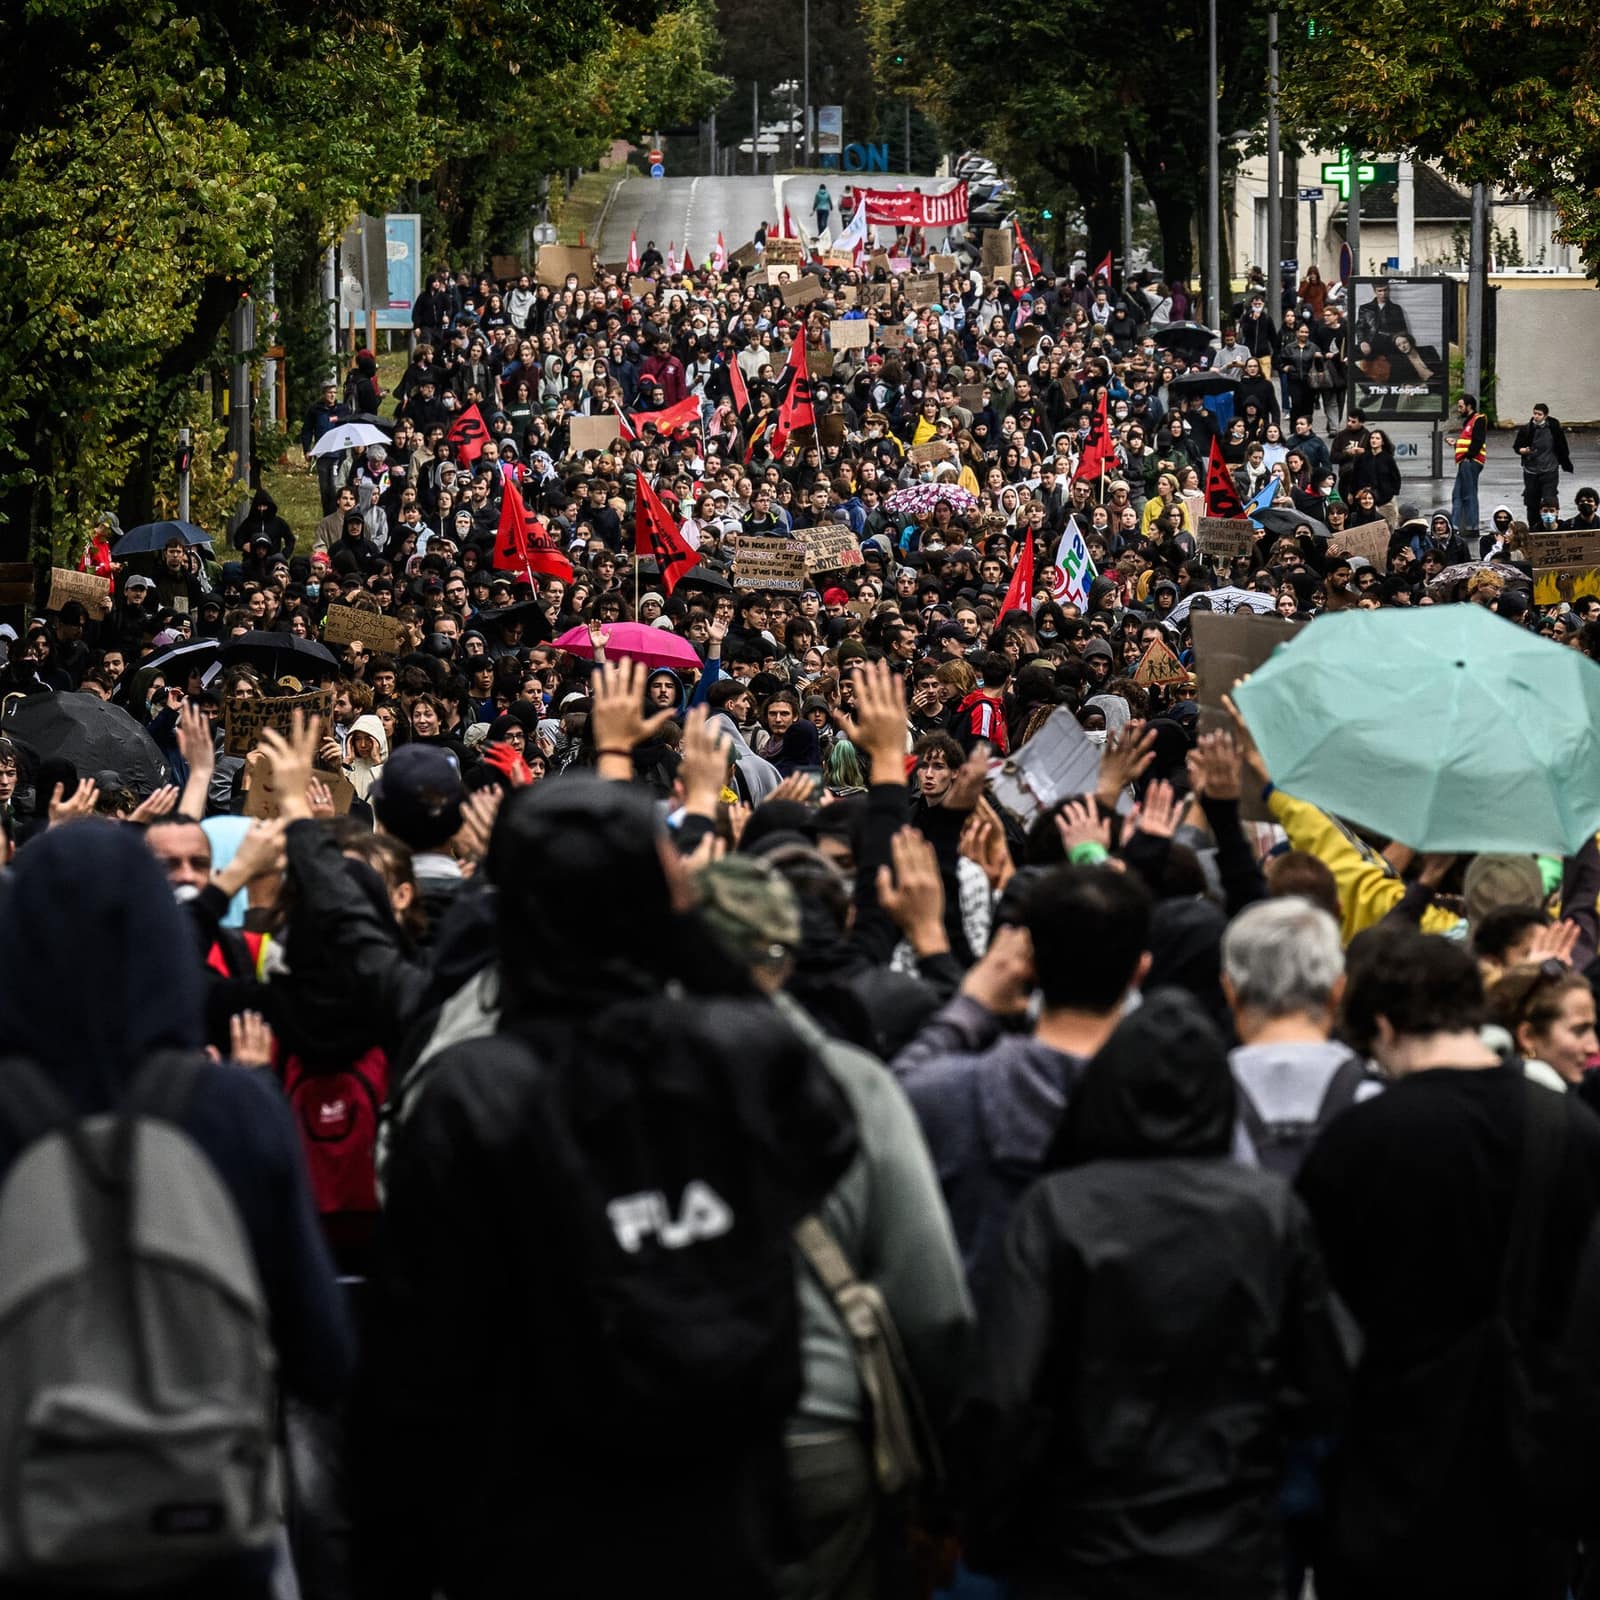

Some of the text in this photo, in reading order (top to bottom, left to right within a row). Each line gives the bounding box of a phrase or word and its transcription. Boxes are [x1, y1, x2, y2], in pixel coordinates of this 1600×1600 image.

[1369, 385, 1430, 396] The Kooples
[1567, 545, 1584, 554] NOT
[815, 555, 841, 571] NOTRE
[229, 701, 250, 713] LA
[229, 714, 268, 727] VEUT
[606, 1179, 735, 1253] FILA
